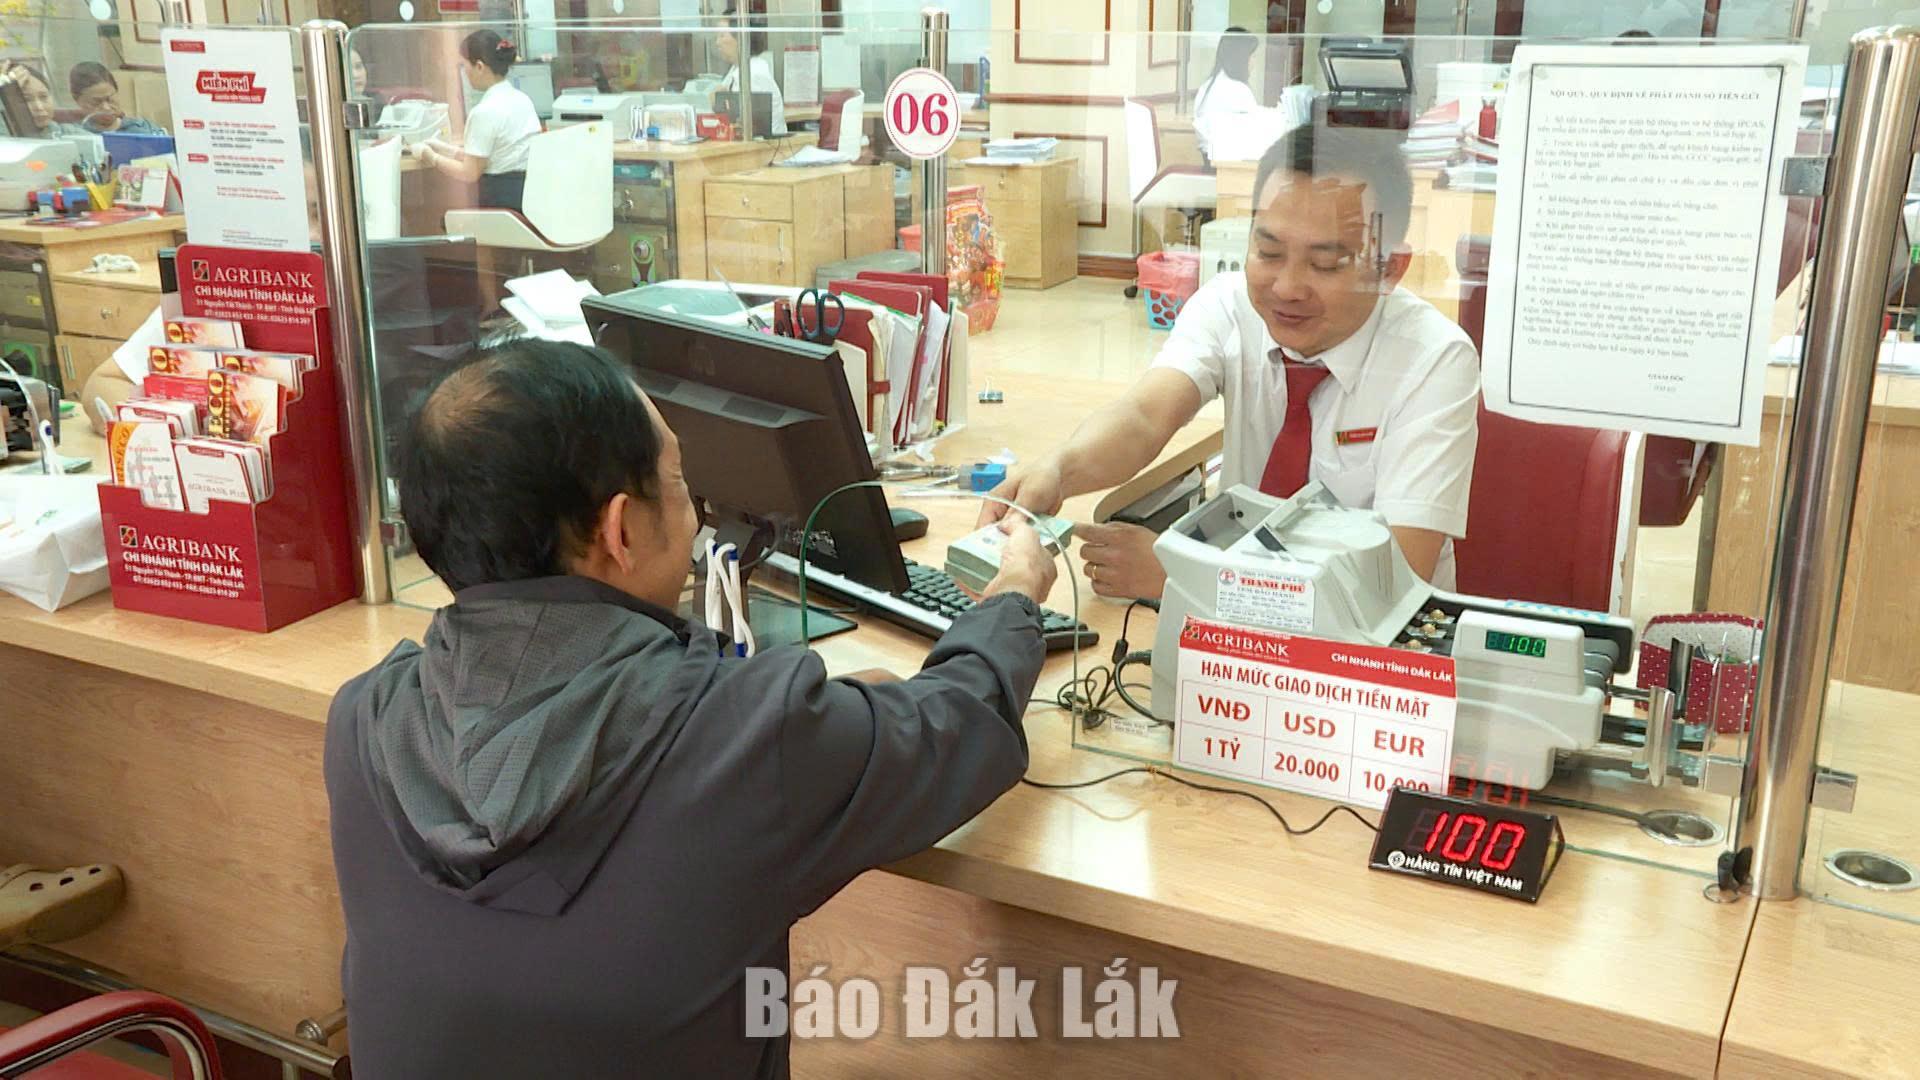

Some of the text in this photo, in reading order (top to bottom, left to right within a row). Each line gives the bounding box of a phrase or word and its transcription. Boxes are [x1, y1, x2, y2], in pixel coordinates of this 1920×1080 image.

[202, 71, 249, 91] MIỀN PHÍ
[893, 92, 949, 136] 06
[214, 267, 313, 288] AGRIBANK
[195, 286, 211, 296] CHI
[213, 286, 247, 299] NHÁNH
[123, 551, 139, 562] CHI
[140, 552, 176, 568] NHÁNH
[142, 535, 241, 562] AGRIBANK
[1240, 577, 1279, 590] THANH
[1202, 631, 1289, 657] AGRIBANK
[1509, 637, 1545, 656] 100
[1331, 653, 1348, 662] CHI
[1349, 654, 1385, 669] NHÁNH
[1201, 660, 1232, 682] HẠN
[1236, 666, 1271, 688] MỨC
[1274, 675, 1311, 695] GIAO
[1315, 681, 1351, 704] DỊCH
[1396, 697, 1430, 720] MẶT
[1198, 694, 1251, 721] VNĐ
[1284, 711, 1336, 738] USD
[1204, 737, 1241, 760] 1 TỶ
[1374, 728, 1425, 758] EUR
[1273, 752, 1340, 782] 20.000
[1425, 811, 1526, 871] 100
[1442, 862, 1463, 878] TÍN
[1465, 868, 1494, 885] VIỆT
[1494, 875, 1524, 891] NAM
